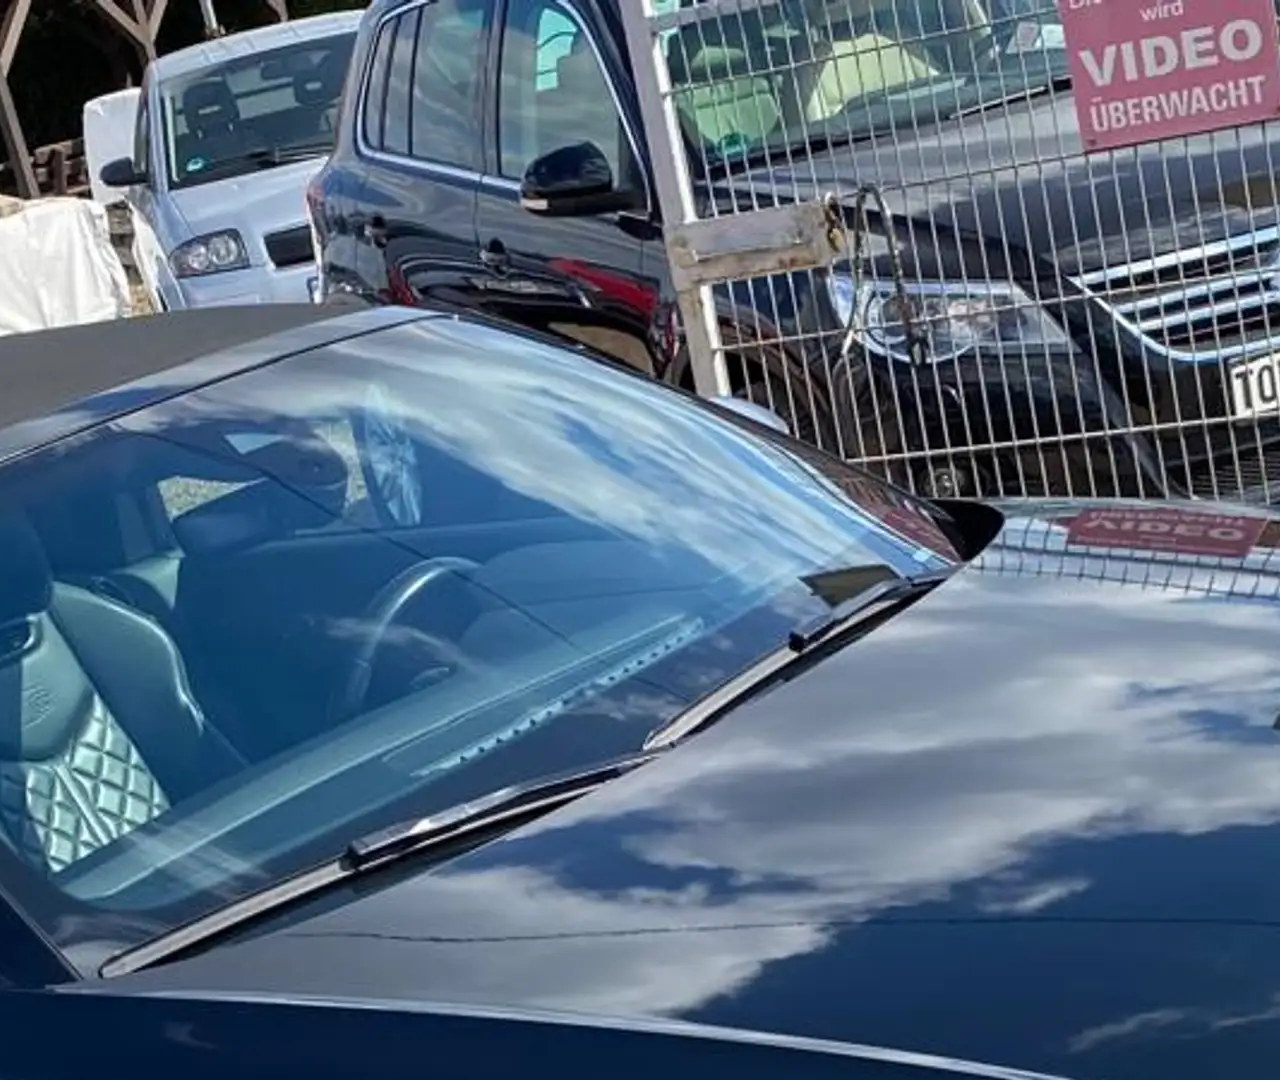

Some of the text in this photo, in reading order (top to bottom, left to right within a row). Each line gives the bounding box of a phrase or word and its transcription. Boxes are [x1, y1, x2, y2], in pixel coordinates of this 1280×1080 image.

[1140, 0, 1184, 22] wird
[1078, 19, 1263, 87] VIDEO
[1089, 75, 1266, 133] ÜBERWACHT
